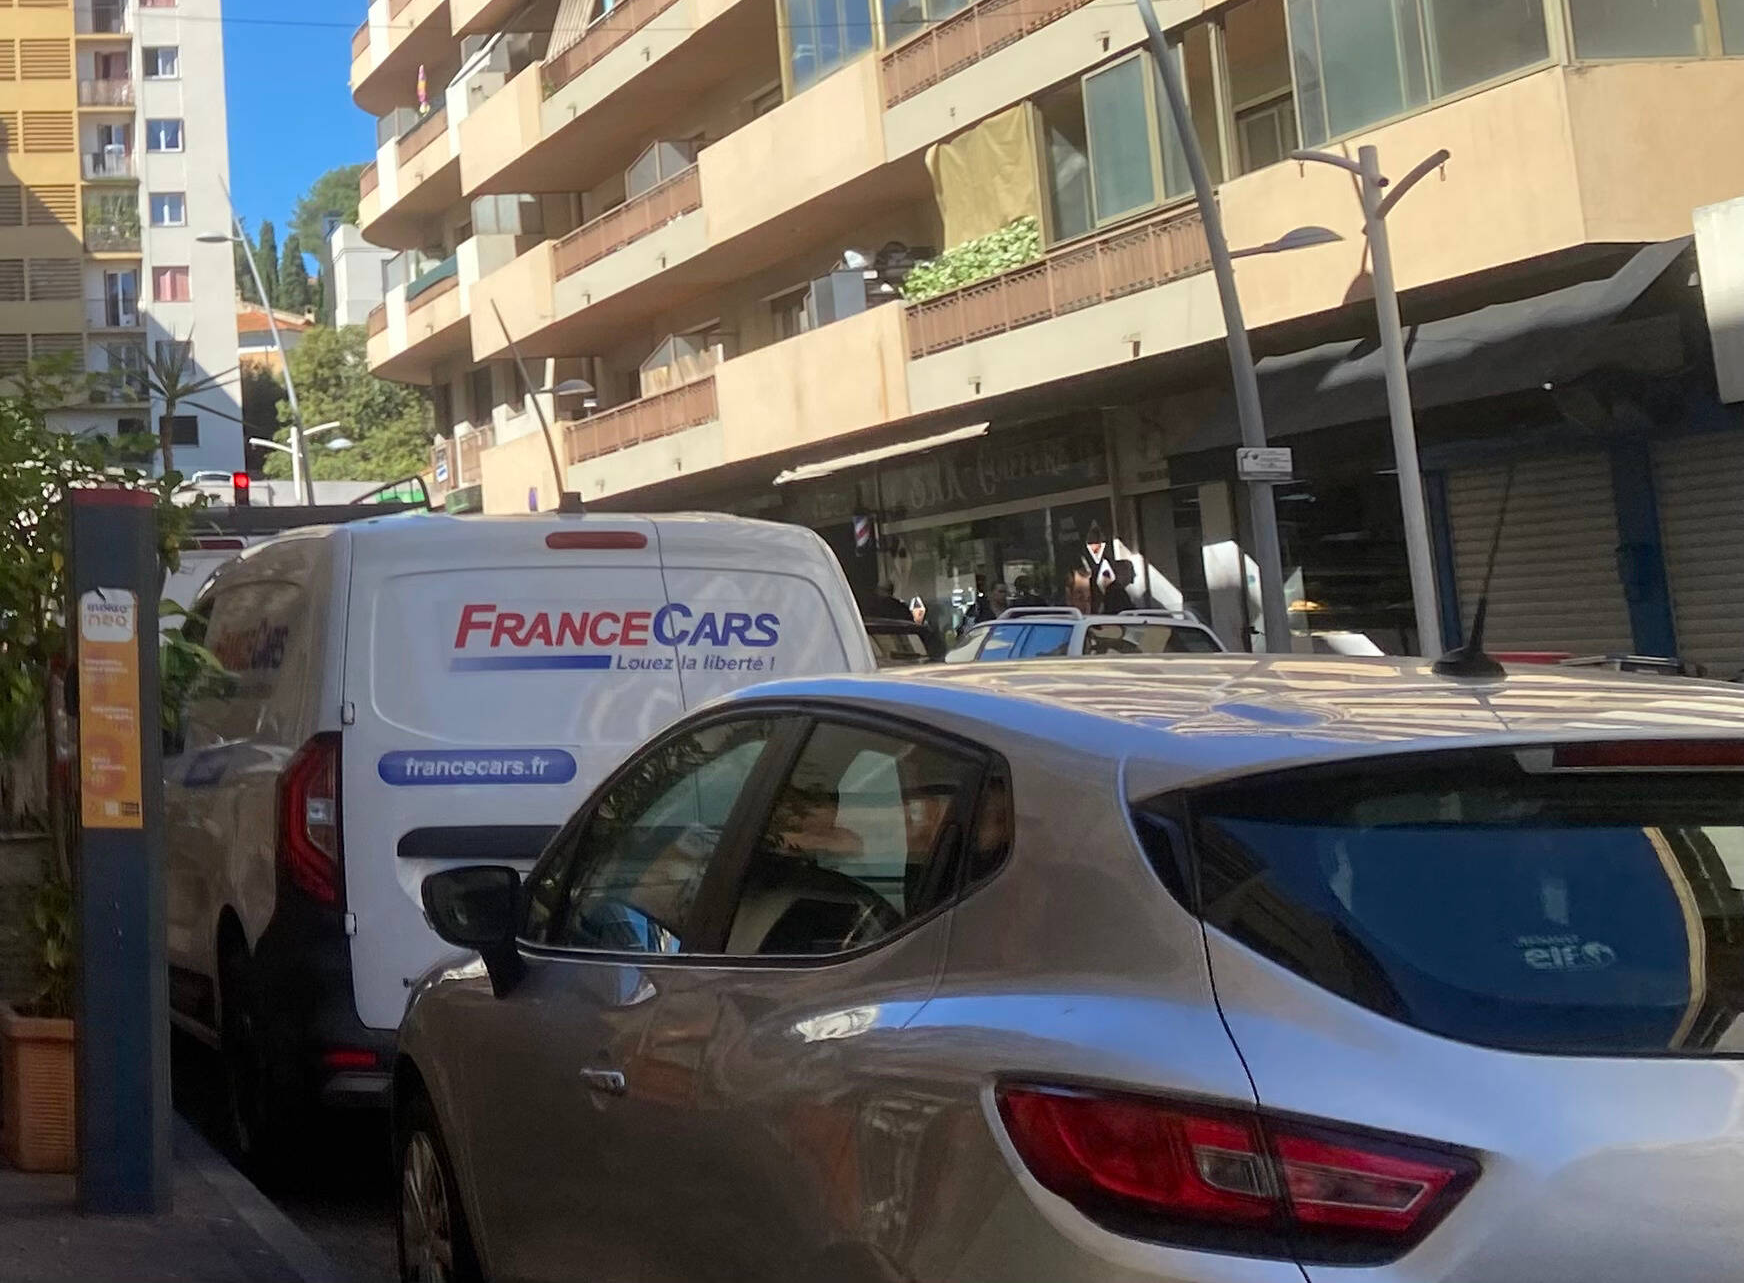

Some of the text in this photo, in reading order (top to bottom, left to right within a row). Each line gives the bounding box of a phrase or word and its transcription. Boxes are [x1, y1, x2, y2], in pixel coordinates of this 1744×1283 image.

[454, 602, 780, 649] FRANCECARS
[616, 655, 674, 671] Louez
[681, 655, 698, 671] la
[703, 654, 764, 672] liberté
[404, 757, 551, 777] francecars.fr
